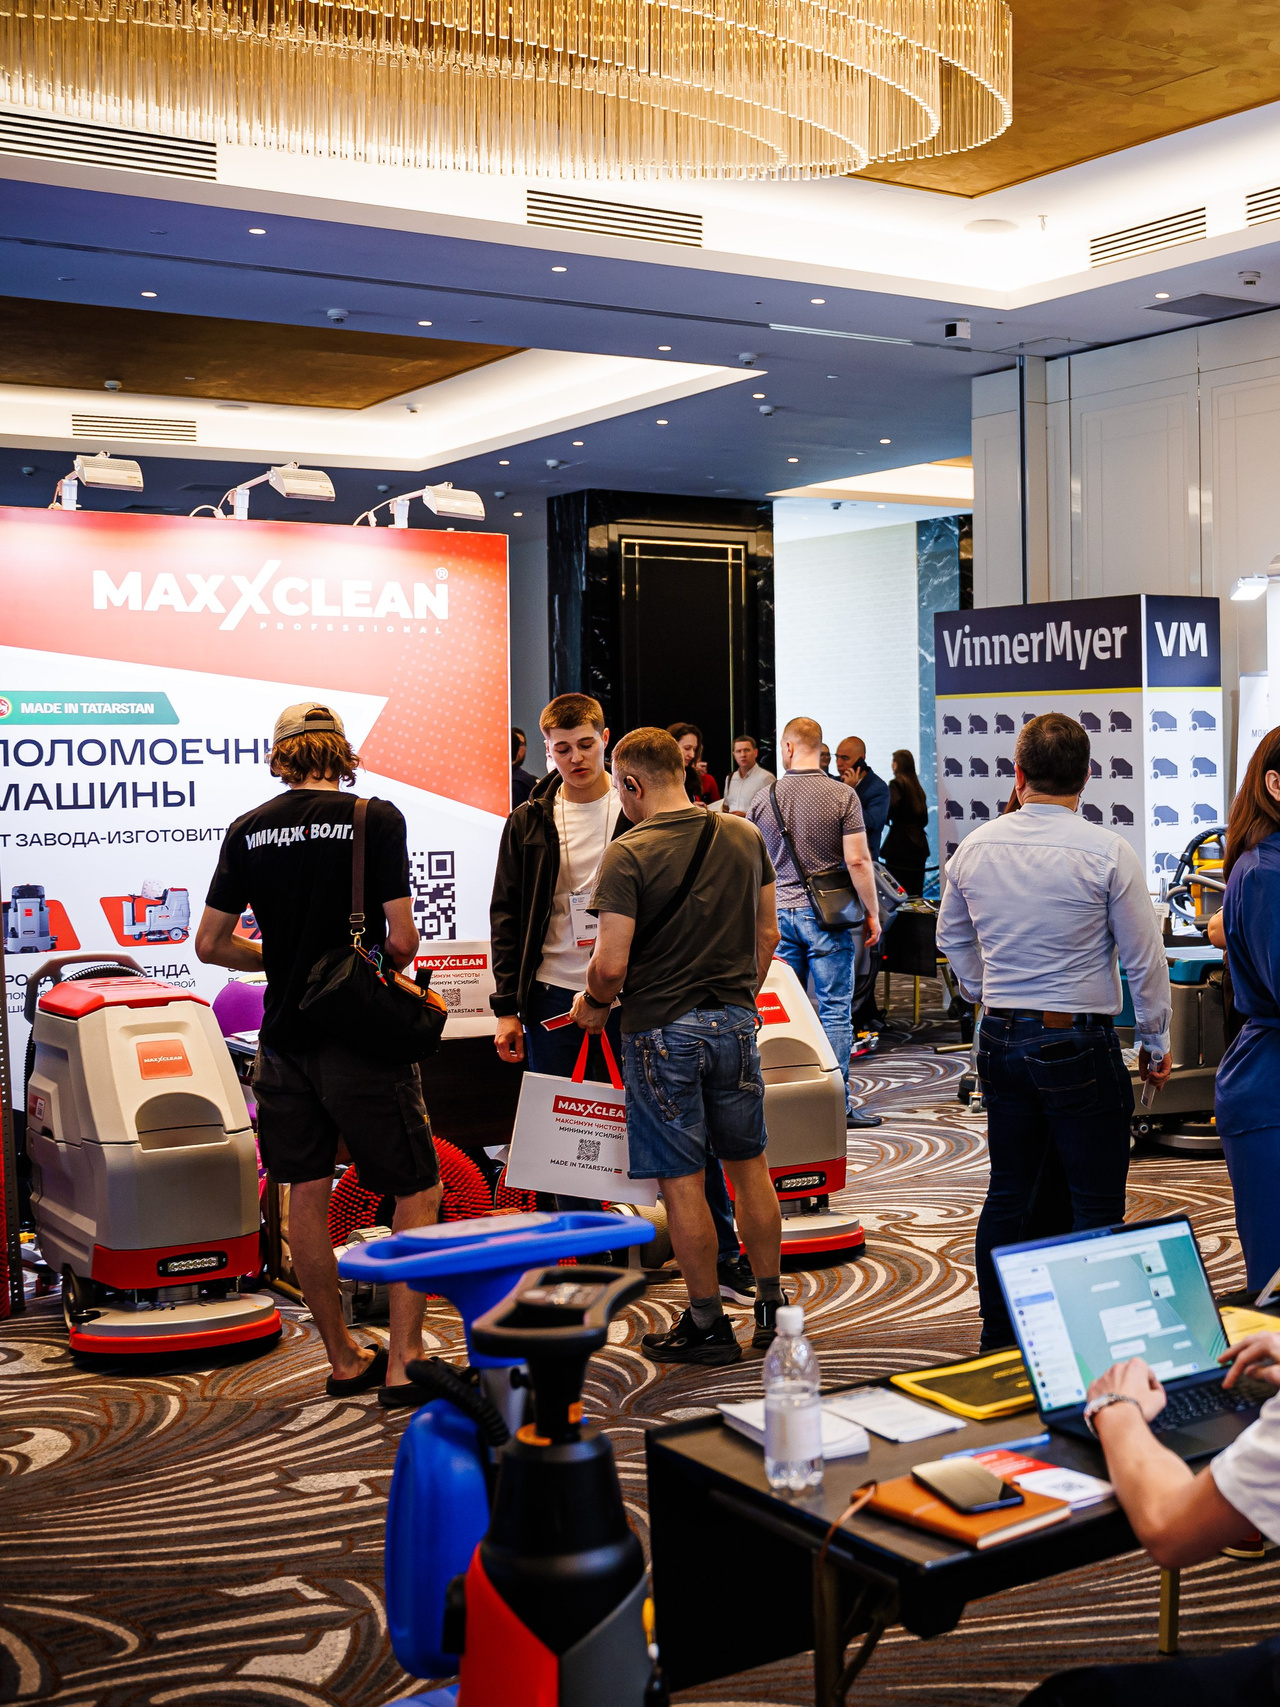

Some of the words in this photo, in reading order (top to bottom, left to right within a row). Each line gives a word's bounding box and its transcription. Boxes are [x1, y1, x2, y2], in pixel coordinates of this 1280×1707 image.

[93, 560, 449, 631] MAXXCLEAN
[260, 622, 442, 635] PROFESSIONAL
[943, 620, 1128, 670] VinnerMyer
[1155, 621, 1209, 657] VM
[21, 702, 63, 714] MADE
[64, 703, 79, 714] IN
[80, 703, 155, 714] TATARSTAN
[0, 833, 11, 847] Т
[15, 827, 229, 848] ЗАВОДА-ИЗГОТОВИТ
[245, 825, 306, 851] ИМИДЖ
[417, 956, 484, 970] MAXXCLEAN
[143, 963, 191, 979] ЕНДА
[143, 1055, 183, 1063] MAXXCLEAN
[557, 1100, 626, 1117] MAXXCLEA
[555, 1116, 593, 1128] МАКСИМУМ
[558, 1126, 593, 1136] МИНИМУМ
[550, 1158, 568, 1166] MADE
[577, 1162, 613, 1173] TATARSTAN
